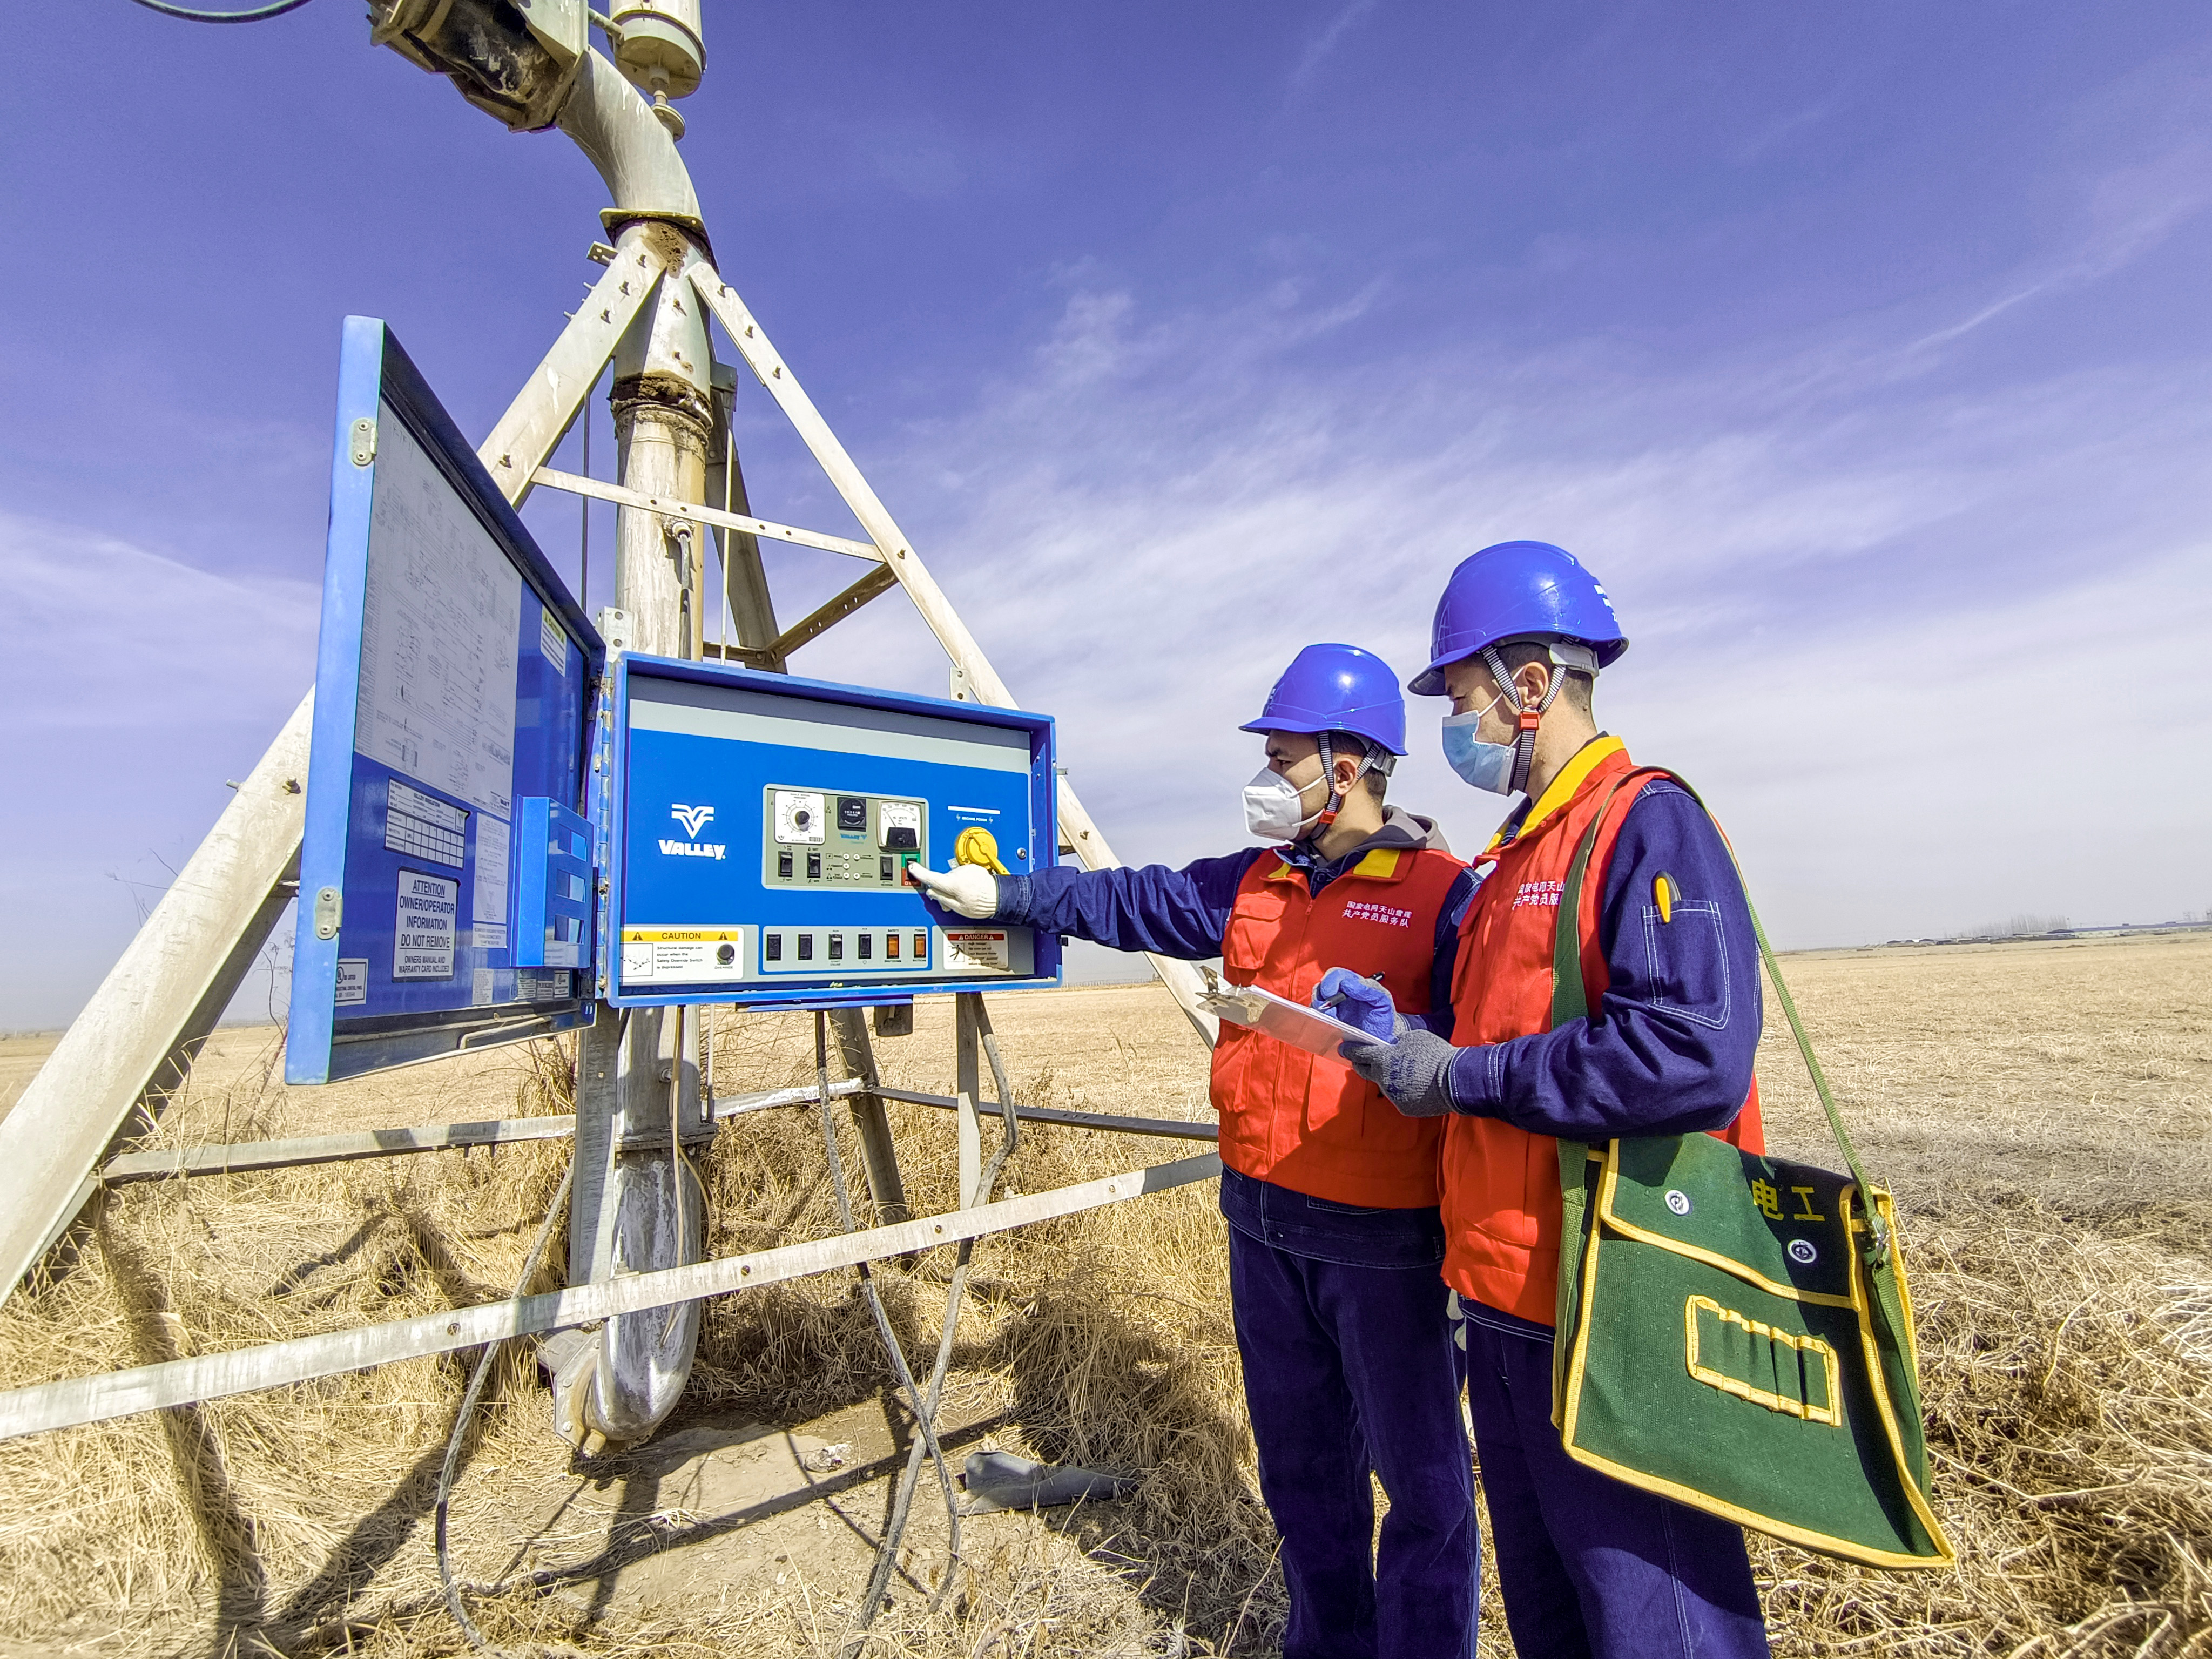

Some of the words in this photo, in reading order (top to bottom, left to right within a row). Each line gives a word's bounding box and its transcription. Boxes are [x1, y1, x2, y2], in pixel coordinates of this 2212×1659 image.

[658, 839, 726, 860] VALLEY
[412, 879, 445, 896] ATTENTION
[399, 895, 455, 915] OWNER/OPERATOR
[406, 915, 447, 930] INFORMATION
[1341, 908, 1409, 928] 共产党员服务队
[401, 934, 411, 946] DO
[412, 934, 426, 947] NOT
[426, 935, 450, 948] REMOVE
[1751, 1177, 1826, 1222] 电工
